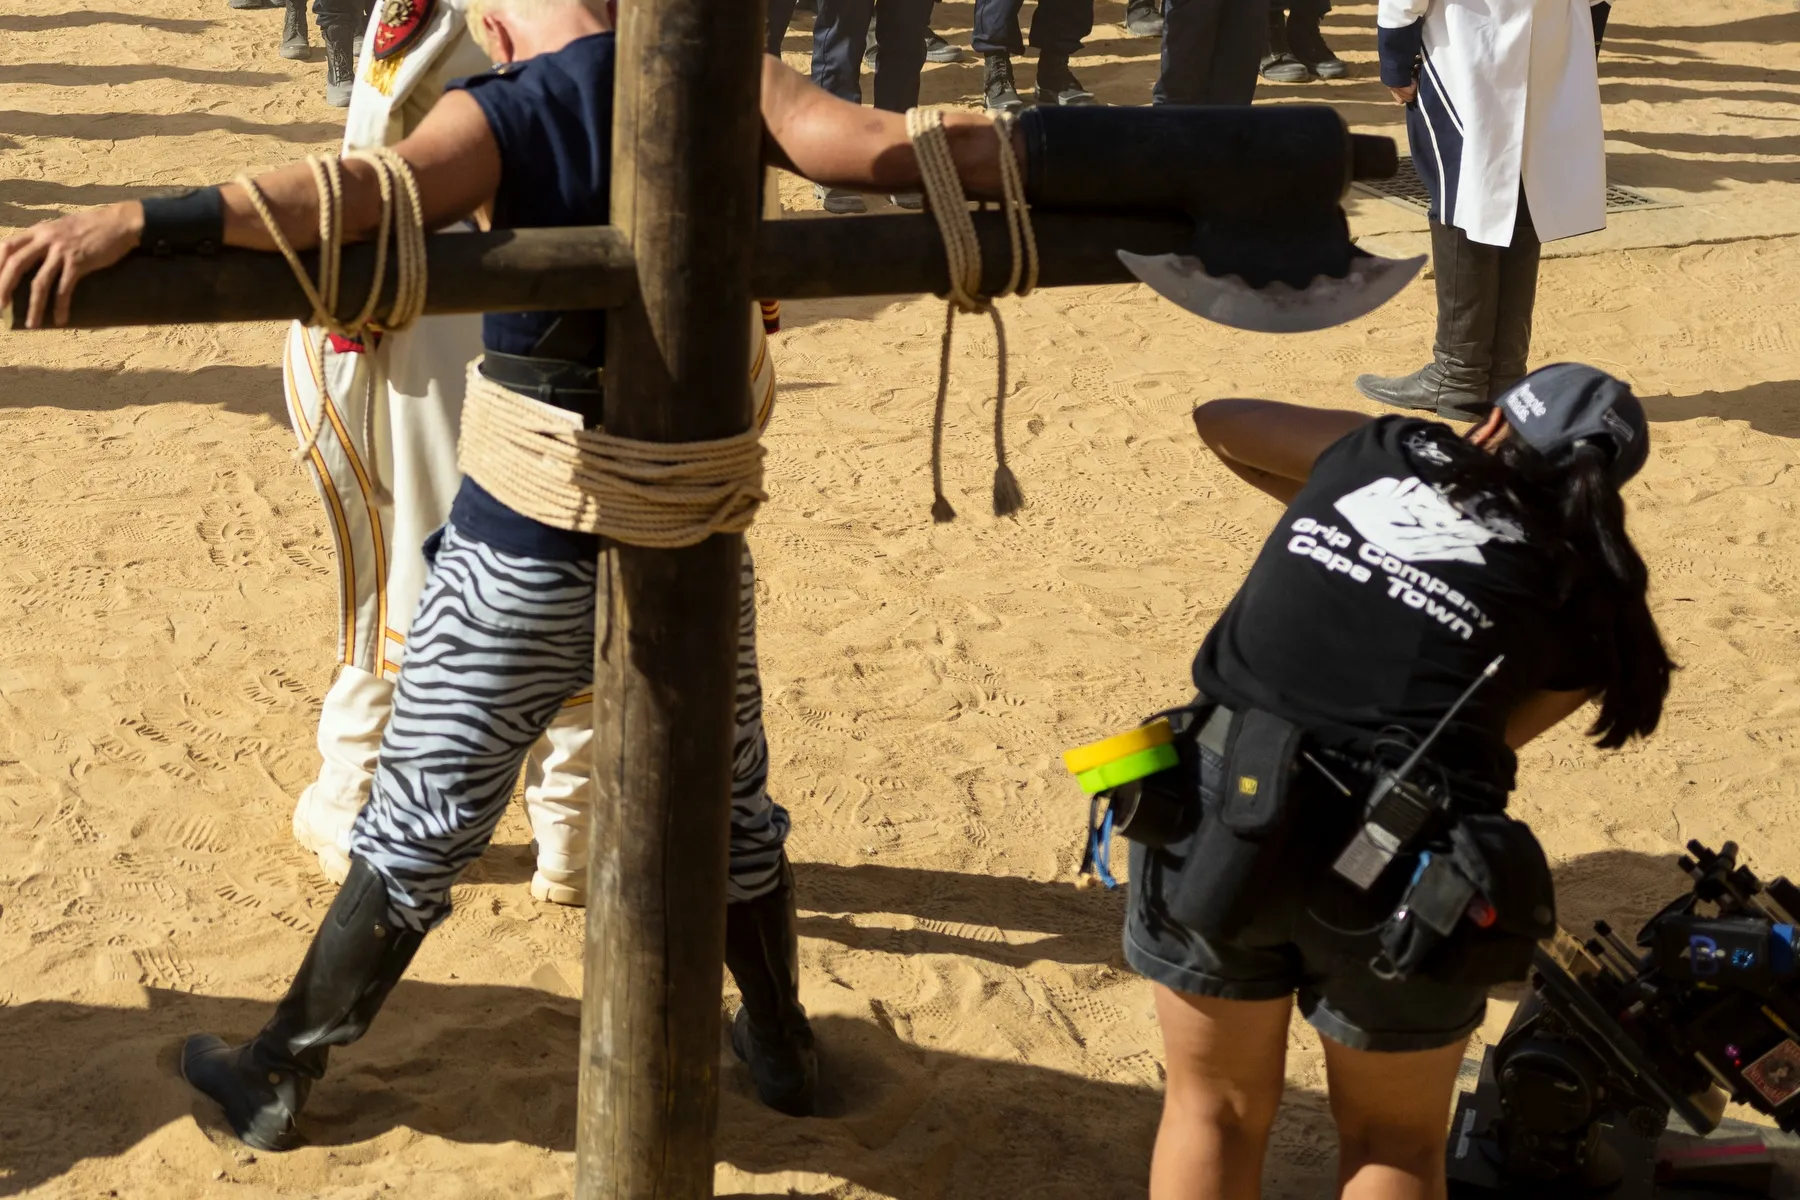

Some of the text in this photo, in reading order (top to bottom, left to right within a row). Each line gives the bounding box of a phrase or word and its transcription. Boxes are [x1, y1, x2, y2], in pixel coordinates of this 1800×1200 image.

[1288, 534, 1474, 641] Cape Town
[1291, 517, 1494, 630] Grip Company
